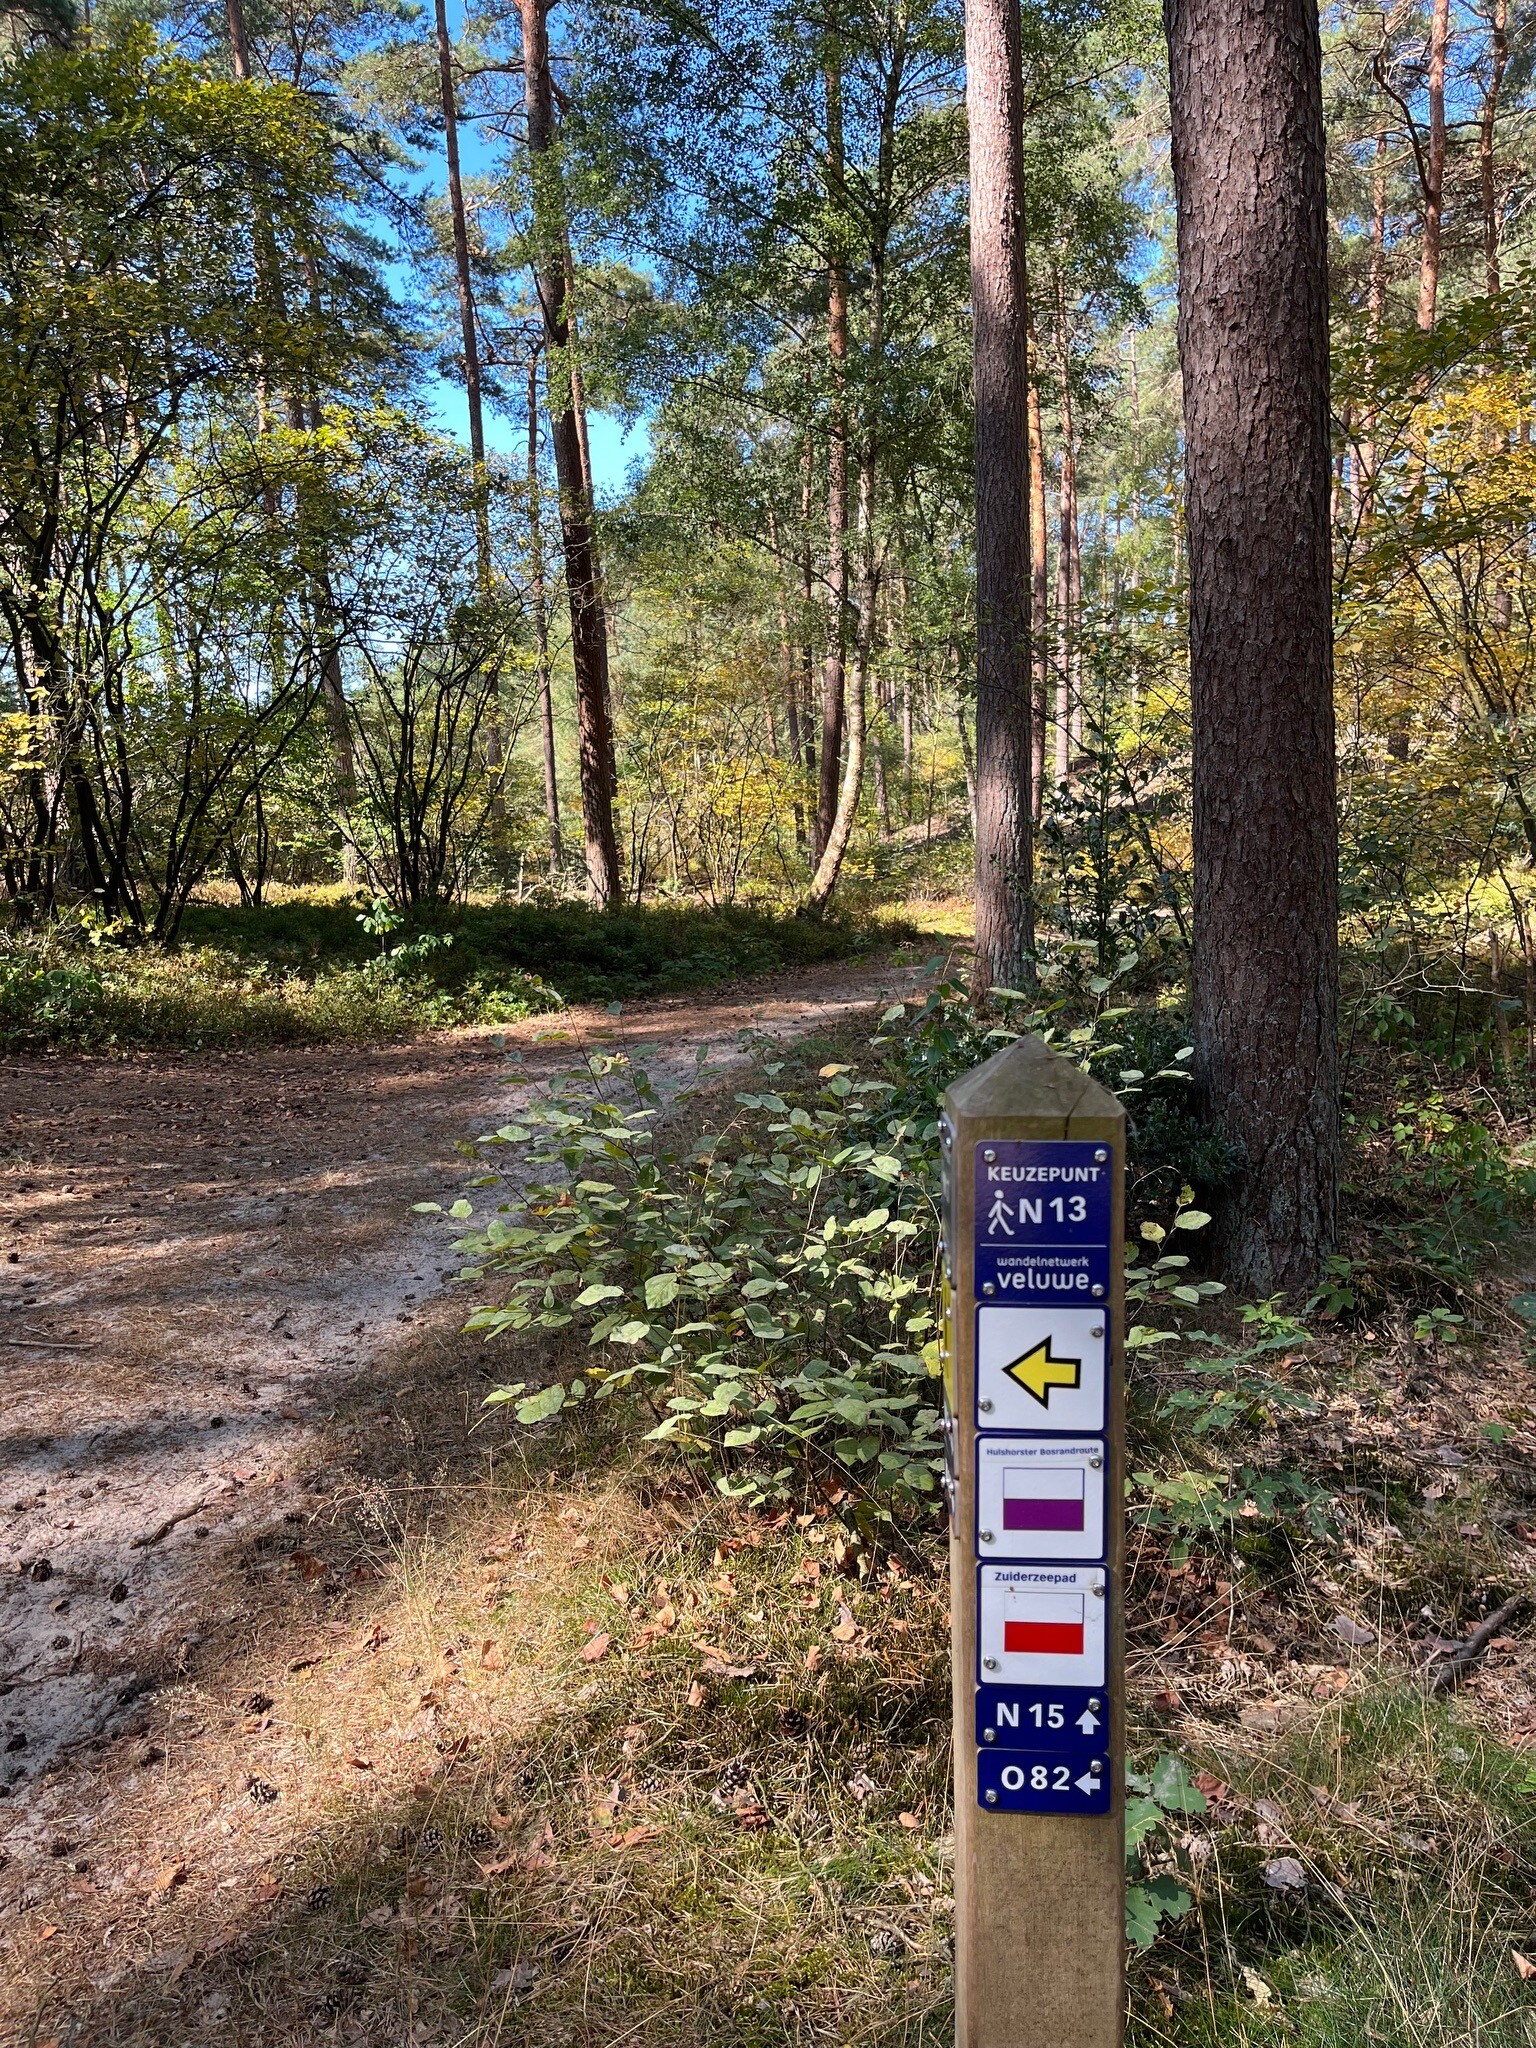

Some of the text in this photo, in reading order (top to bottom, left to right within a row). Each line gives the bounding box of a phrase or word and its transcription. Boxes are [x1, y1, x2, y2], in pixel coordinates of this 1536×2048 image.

[987, 1166, 1100, 1182] KEUZEPUNT
[1018, 1195, 1087, 1224] N 13
[996, 1256, 1090, 1268] wandelnetwerk
[996, 1267, 1090, 1290] veluwe
[1039, 1446, 1099, 1456] Bosrandroute
[994, 1571, 1077, 1584] Zuiderzeepad
[996, 1702, 1065, 1729] N 15
